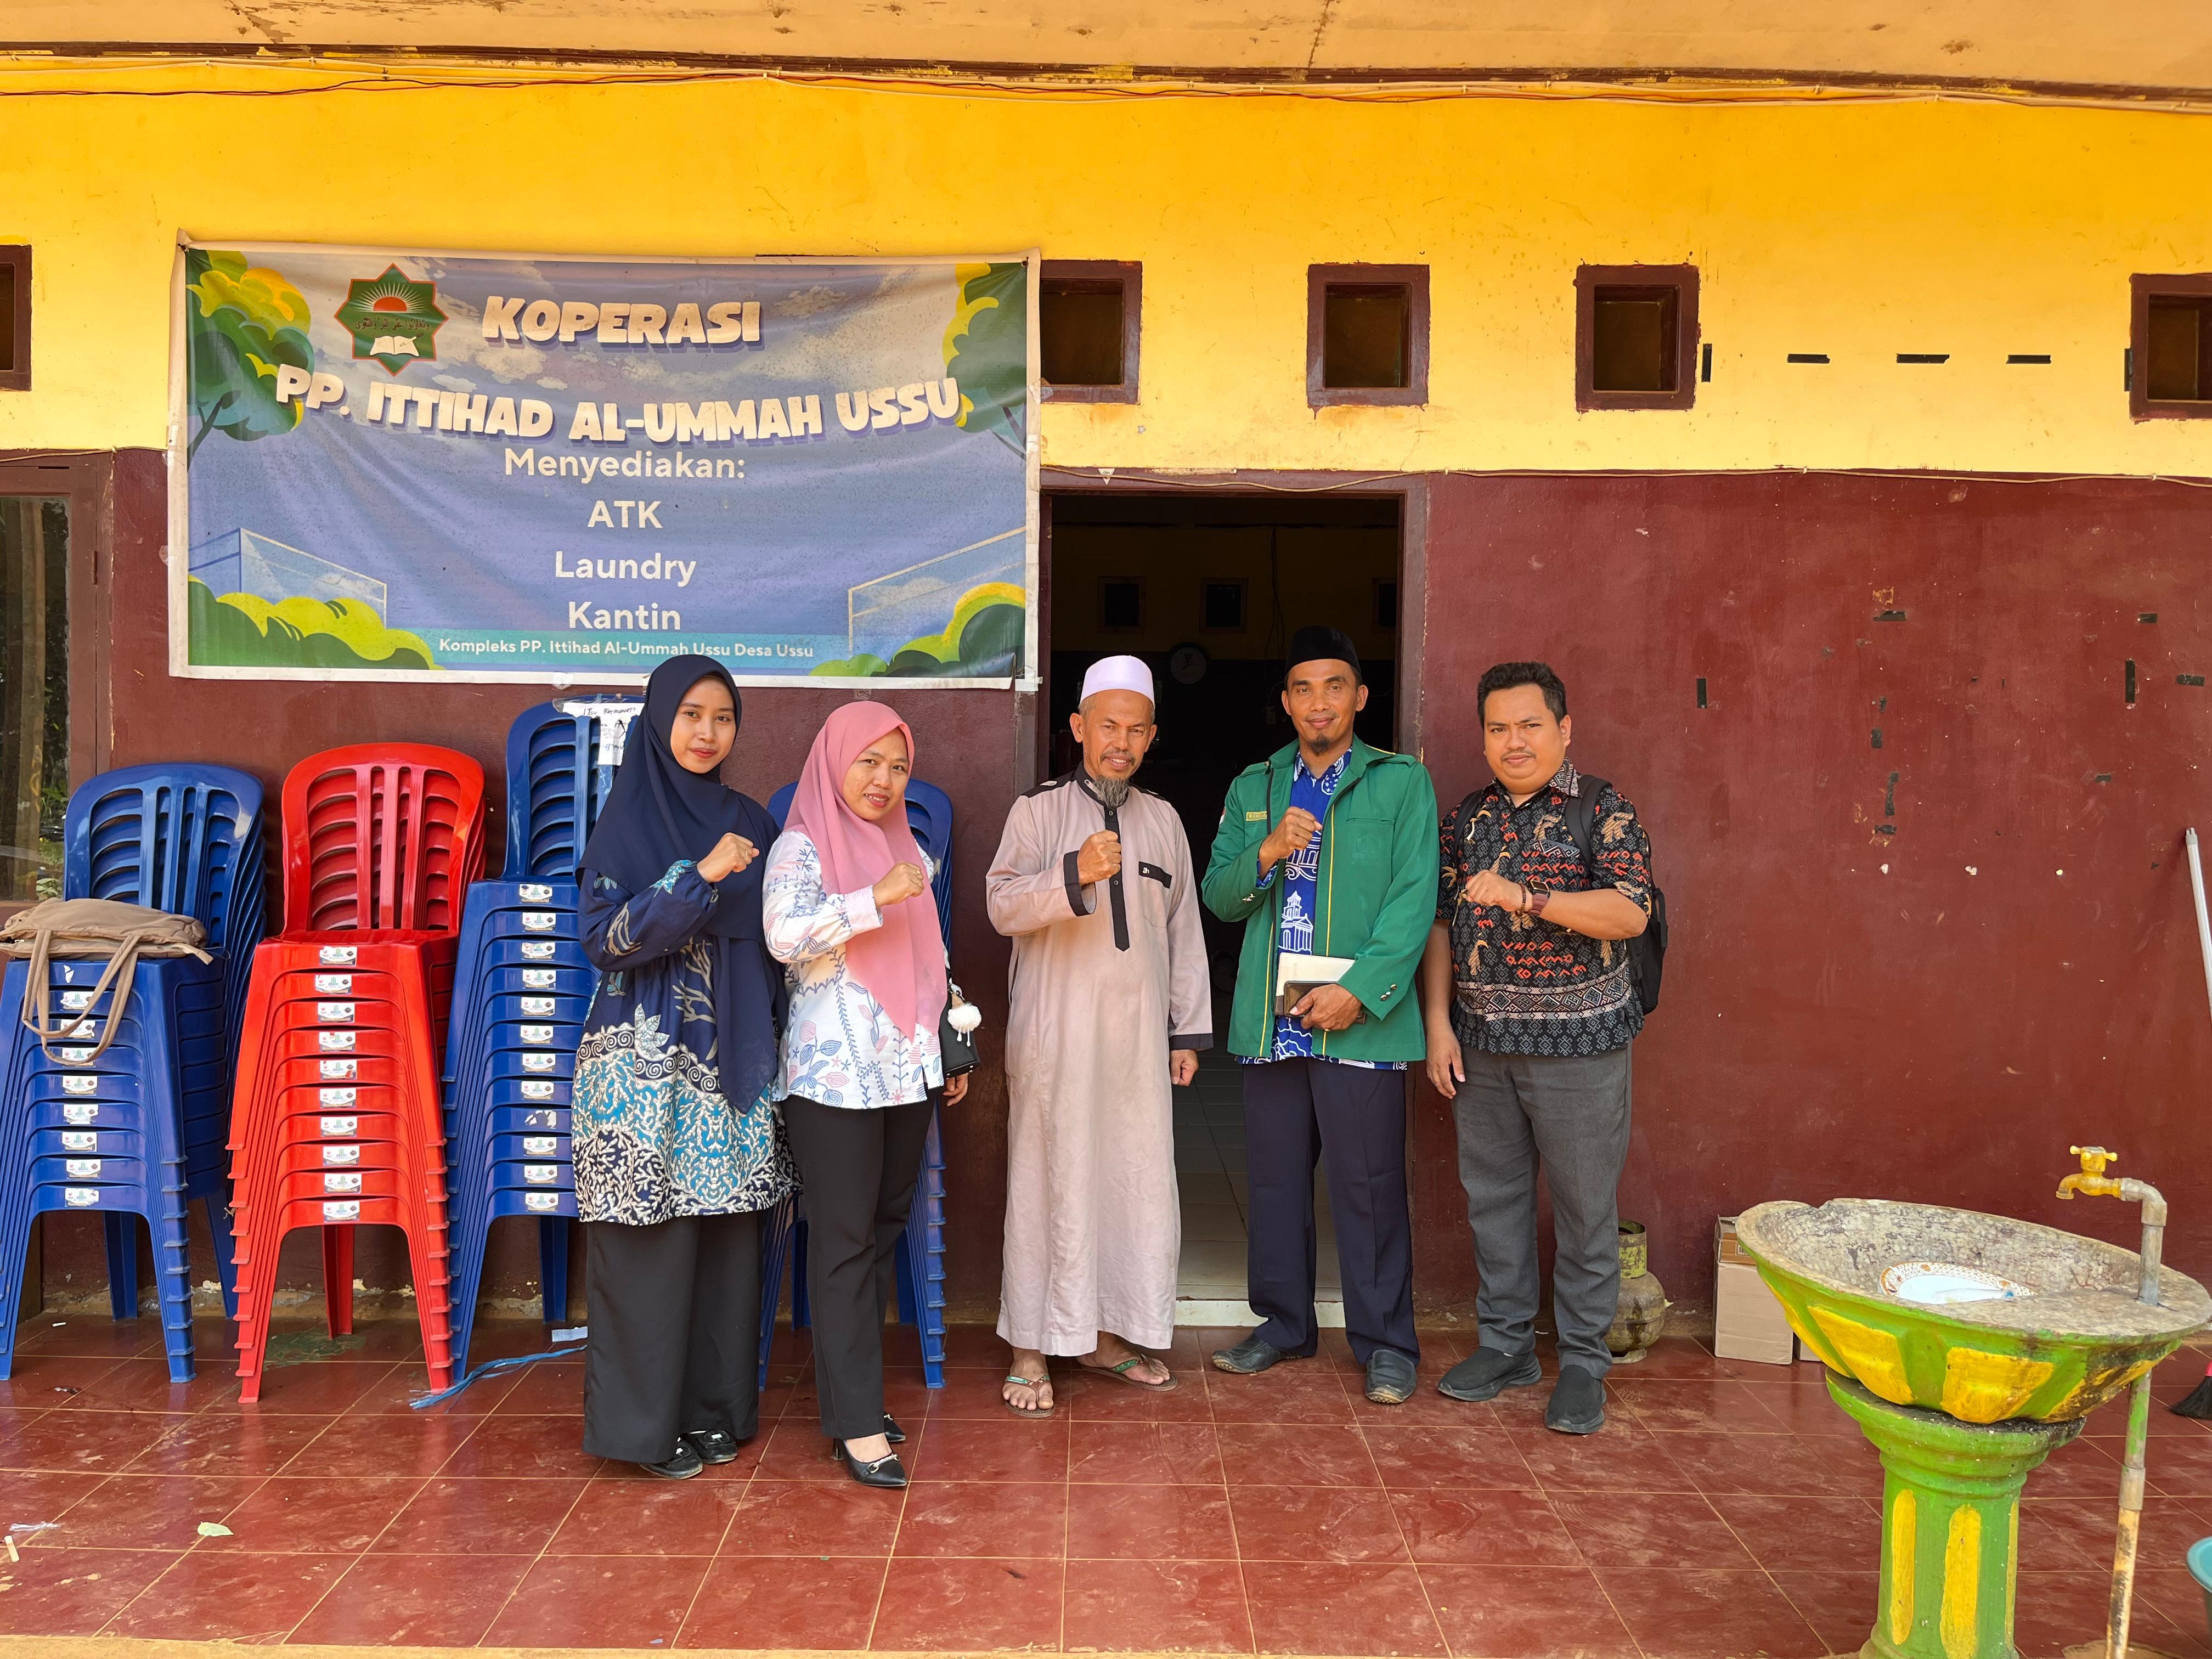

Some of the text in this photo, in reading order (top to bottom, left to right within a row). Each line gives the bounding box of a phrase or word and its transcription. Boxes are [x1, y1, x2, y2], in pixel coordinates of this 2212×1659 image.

[482, 296, 763, 347] KOPERASI
[276, 363, 962, 443] PP. ITTIHAD AL-UMMAH USSU
[505, 448, 745, 484] Menyediakan:
[587, 500, 663, 528] ATK
[555, 551, 697, 588] Laundry
[569, 601, 681, 630] Kantin
[439, 638, 814, 657] Kompleks PP. Ittihad Al-Ummah Ussu Desa Ussu
